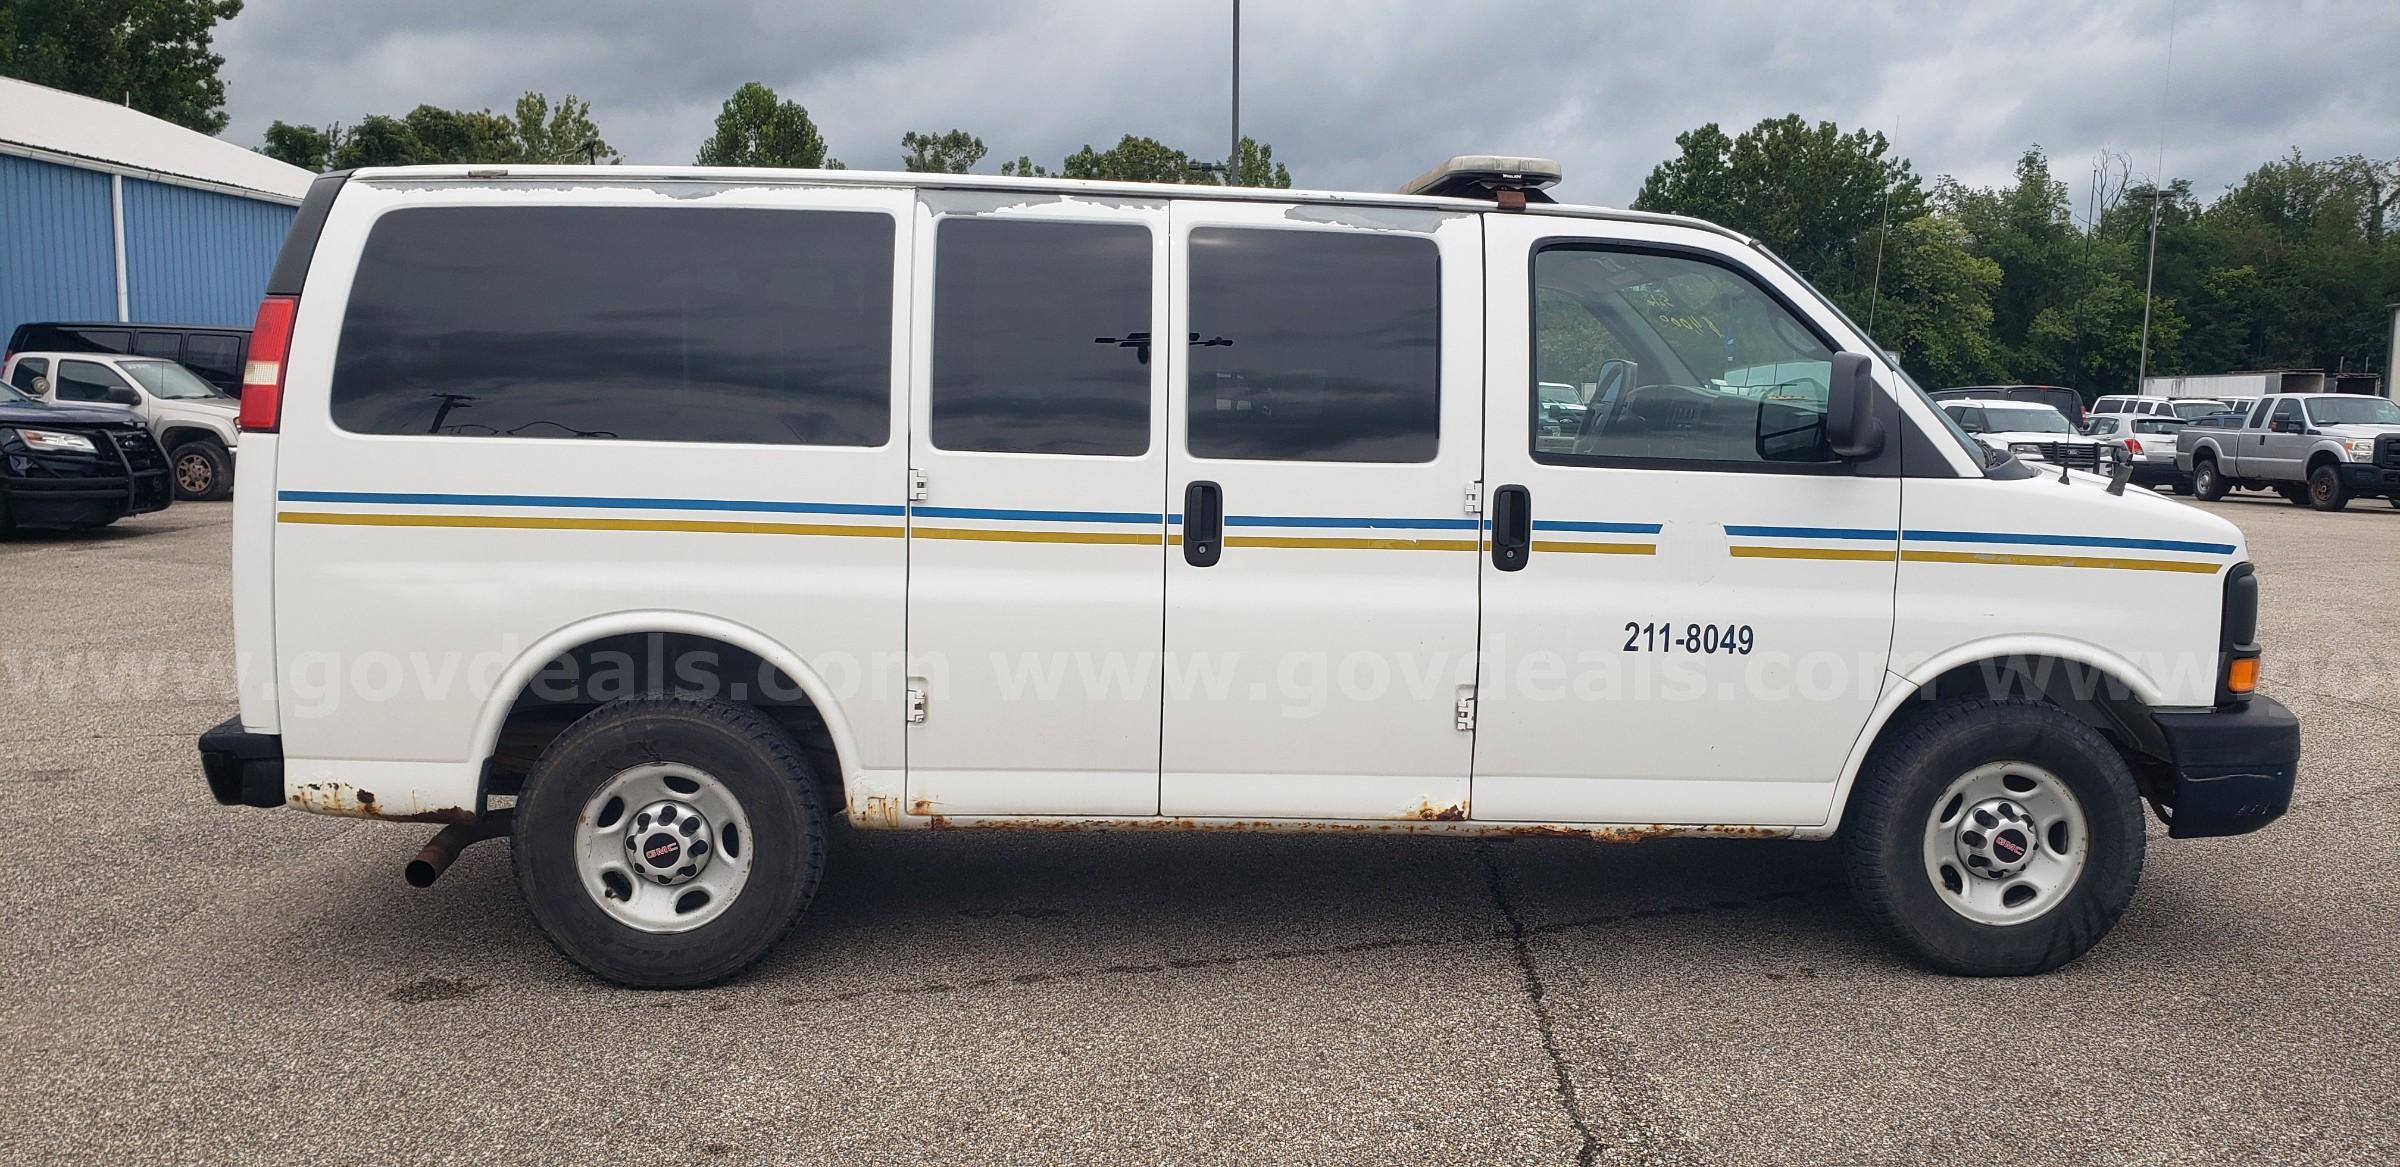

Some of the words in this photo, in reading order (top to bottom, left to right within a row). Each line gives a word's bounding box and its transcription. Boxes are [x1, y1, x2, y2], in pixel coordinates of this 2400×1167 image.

[1622, 621, 1754, 655] 211-8049
[645, 842, 679, 859] GMC
[1995, 836, 2025, 856] GMC
